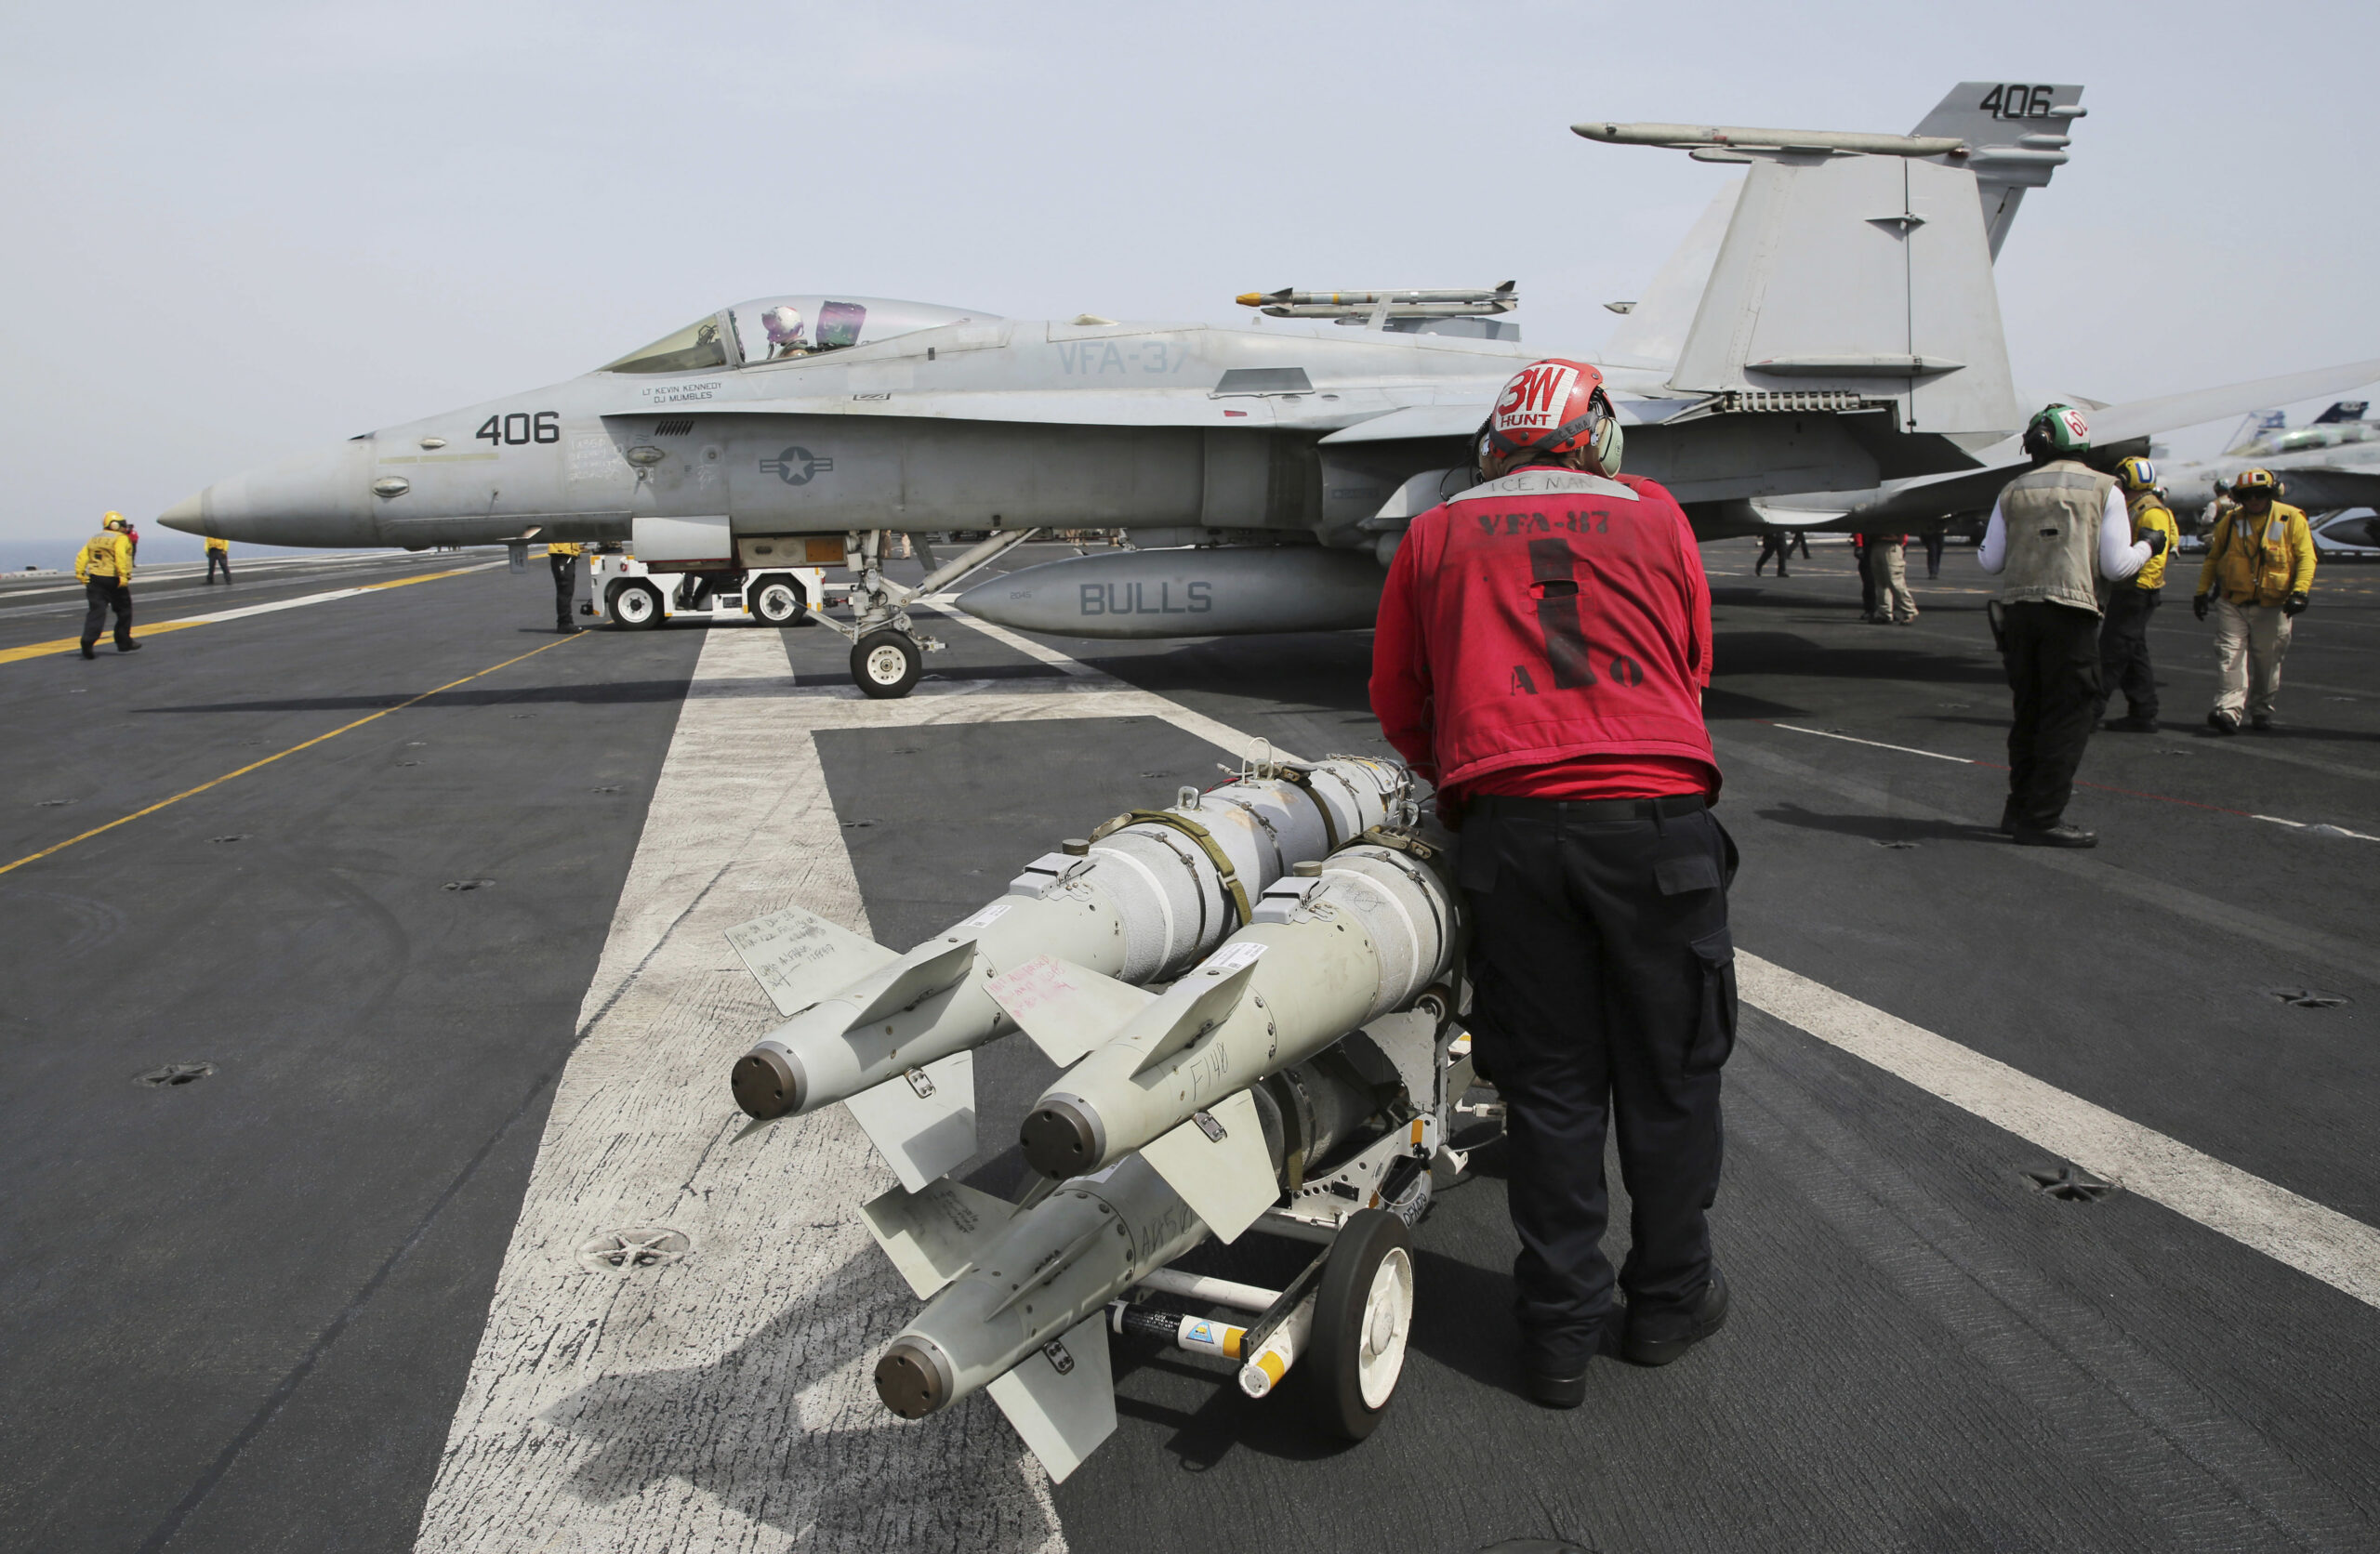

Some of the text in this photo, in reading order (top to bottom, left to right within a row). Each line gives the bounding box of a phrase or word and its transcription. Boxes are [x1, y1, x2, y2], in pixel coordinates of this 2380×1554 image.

[1979, 84, 2054, 119] 406
[1056, 341, 1192, 375] VFA-37
[642, 382, 722, 396] LT KEVIN KENNEDY
[669, 391, 713, 402] MUMBLES
[1498, 367, 1567, 416] 3W
[476, 411, 560, 446] 406
[1501, 415, 1552, 428] HUNT
[1491, 476, 1534, 492] ICE
[1478, 510, 1611, 535] VFA-87
[1079, 582, 1212, 615] BULLS
[1510, 665, 1539, 696] A
